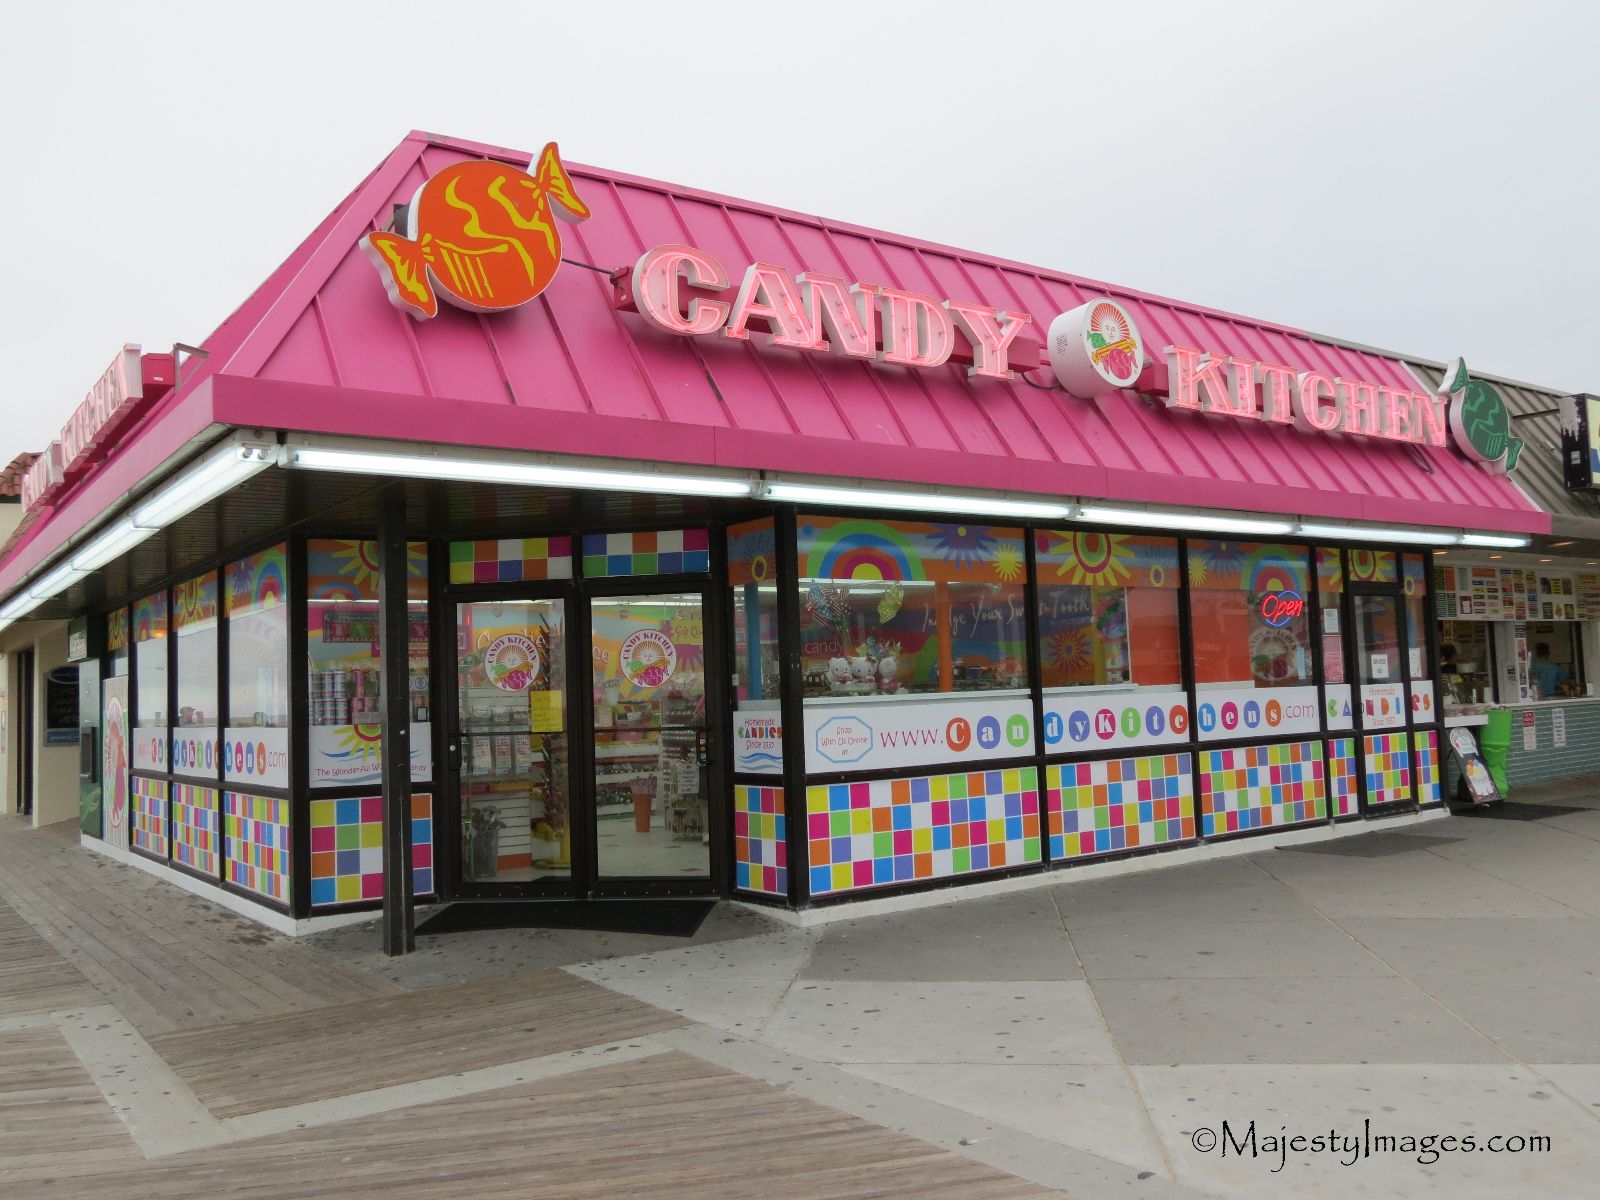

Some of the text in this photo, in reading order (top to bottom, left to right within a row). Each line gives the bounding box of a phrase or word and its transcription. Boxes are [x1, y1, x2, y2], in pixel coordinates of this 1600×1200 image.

[631, 243, 1447, 448] CANDY KITCHEN
[1262, 594, 1304, 623] Open
[487, 636, 537, 664] CANDY KITCHEN
[623, 634, 641, 660] CANDY
[643, 632, 674, 657] KITCHEN
[744, 717, 775, 726] Homemade
[836, 726, 853, 736] Shop
[746, 739, 762, 750] Since
[821, 737, 837, 746] With
[848, 737, 868, 745] Online
[316, 768, 329, 776] The
[331, 765, 370, 777] Wonderful
[410, 764, 427, 772] andy
